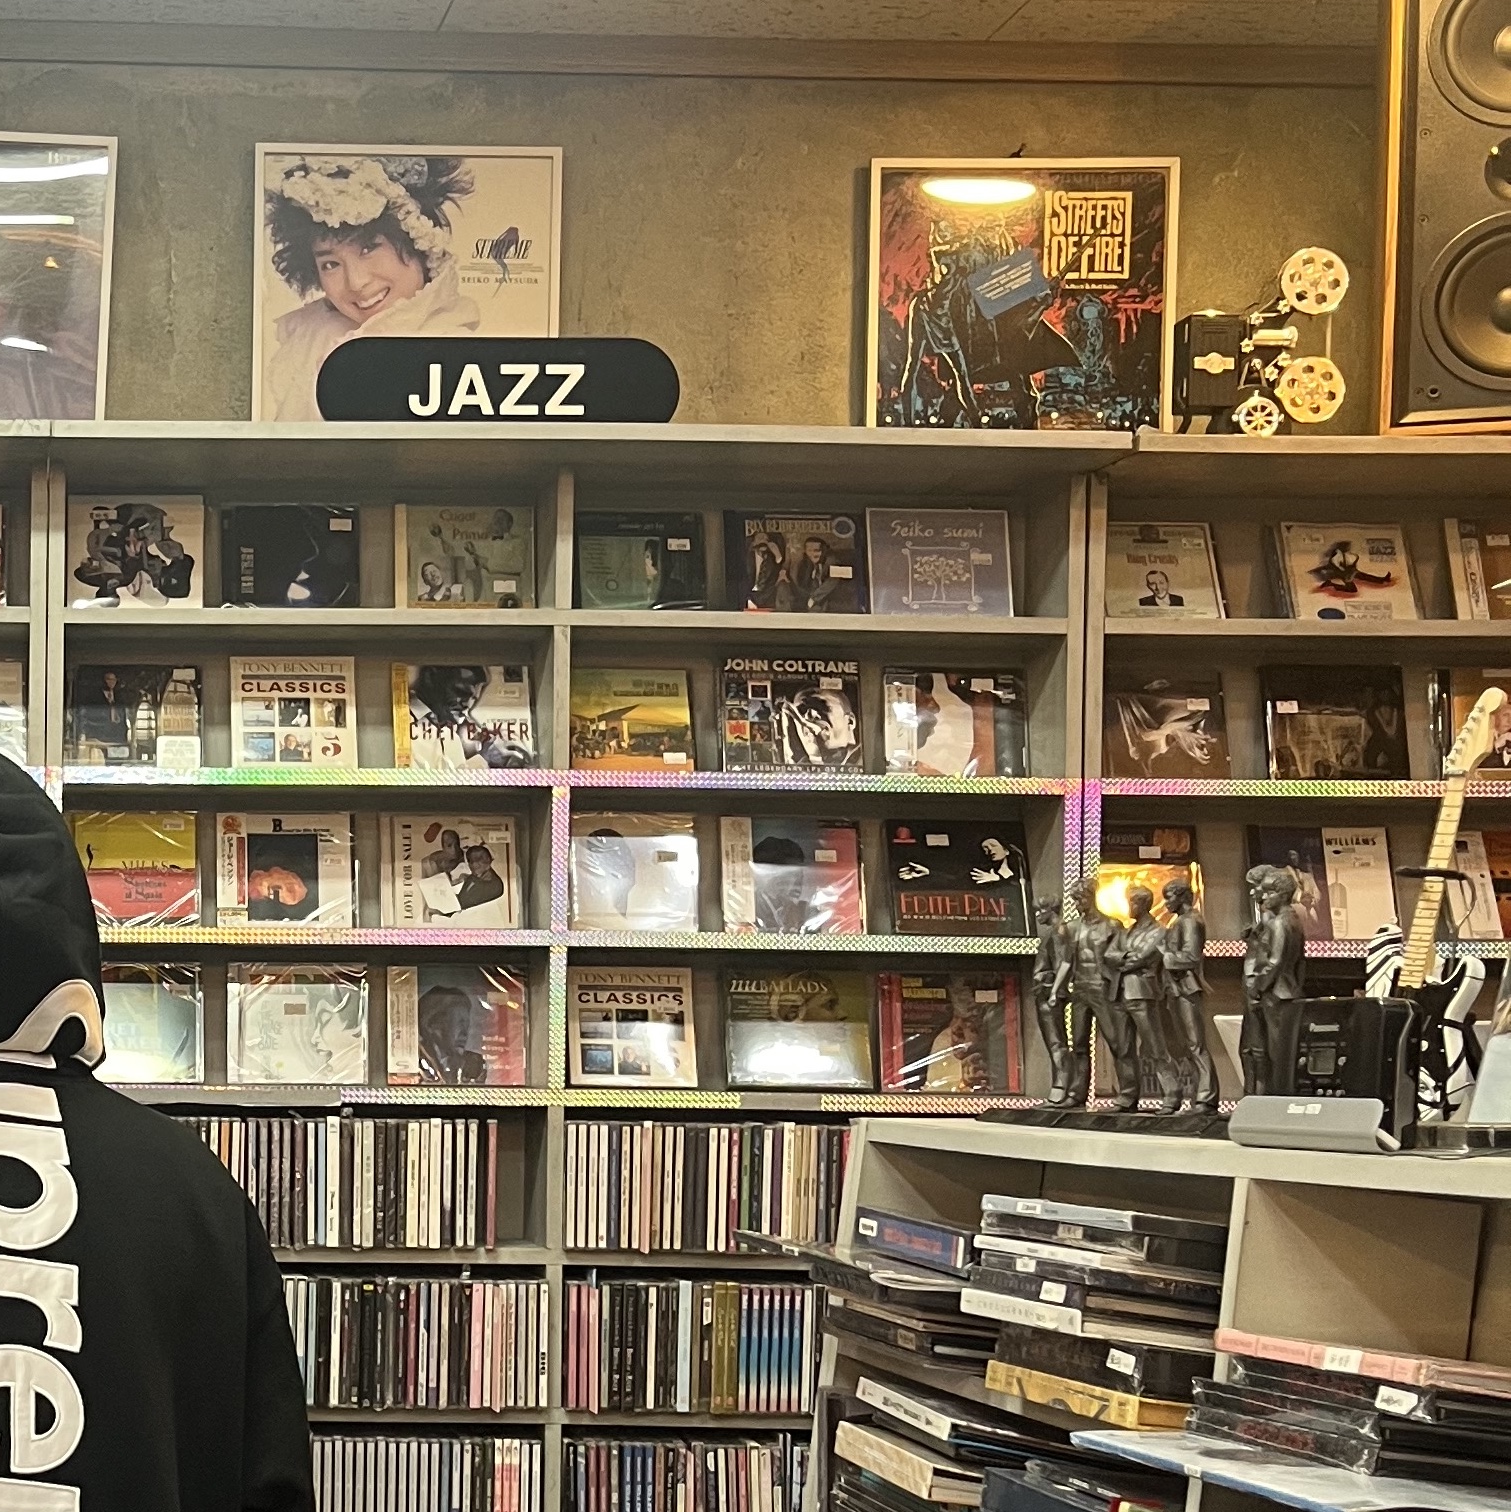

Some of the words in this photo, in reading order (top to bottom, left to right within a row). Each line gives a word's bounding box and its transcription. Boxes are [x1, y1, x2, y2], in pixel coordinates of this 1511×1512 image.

[1051, 191, 1125, 236] STREETS
[408, 363, 586, 417] JAZZ
[890, 519, 935, 540] Seiko
[241, 662, 279, 674] TONY
[283, 662, 346, 674] BENNETT
[724, 657, 770, 674] JOHN
[772, 658, 859, 674] COLTRANE
[240, 680, 347, 695] CLASSICS
[577, 972, 616, 985] TONY
[618, 973, 683, 986] BENNETT
